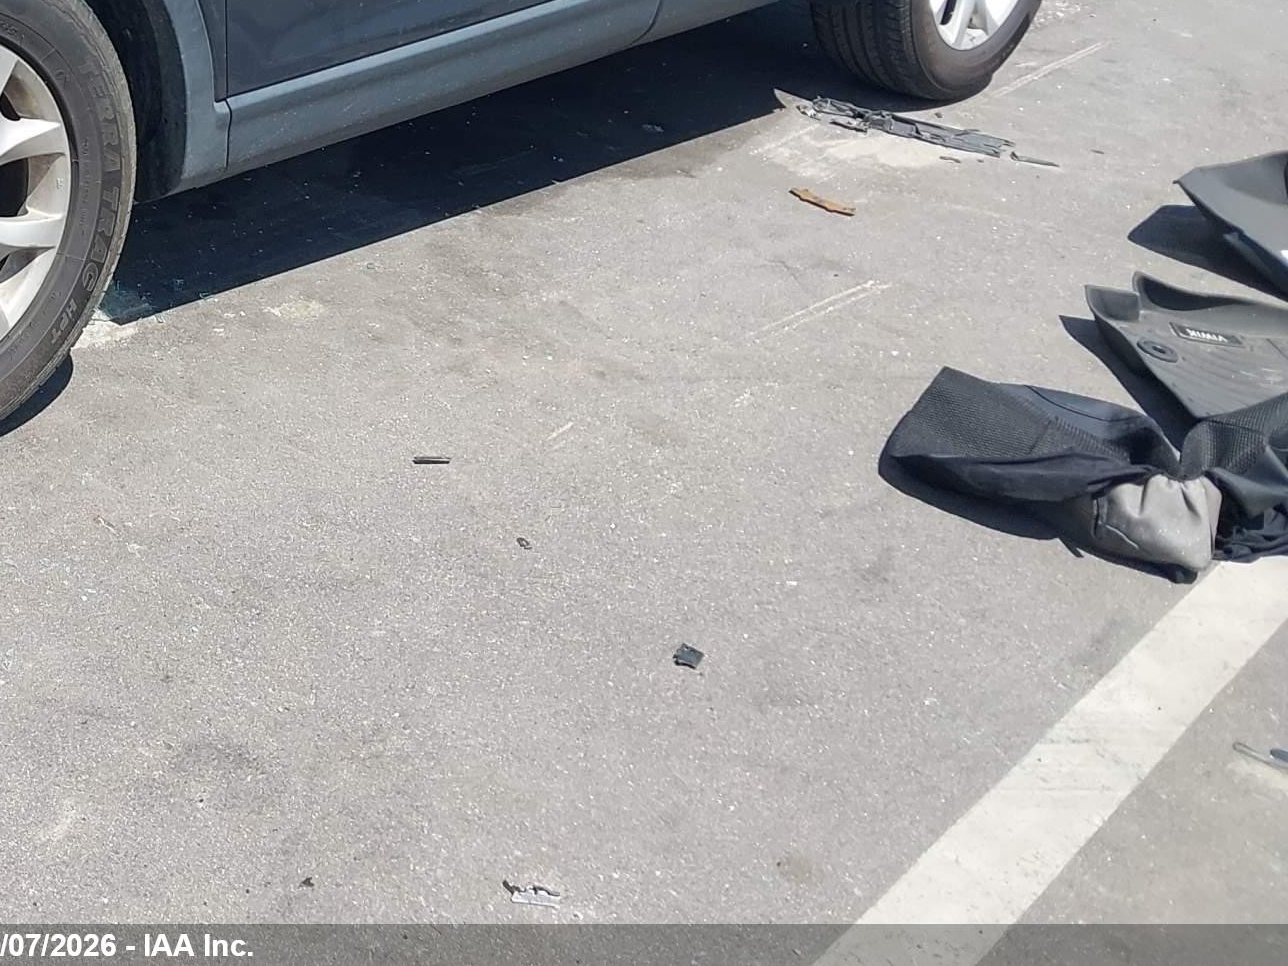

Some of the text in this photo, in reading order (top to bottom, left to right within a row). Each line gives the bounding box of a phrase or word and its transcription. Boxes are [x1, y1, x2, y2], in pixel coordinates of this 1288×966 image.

[50, 57, 123, 346] TERRA TRAC HPT
